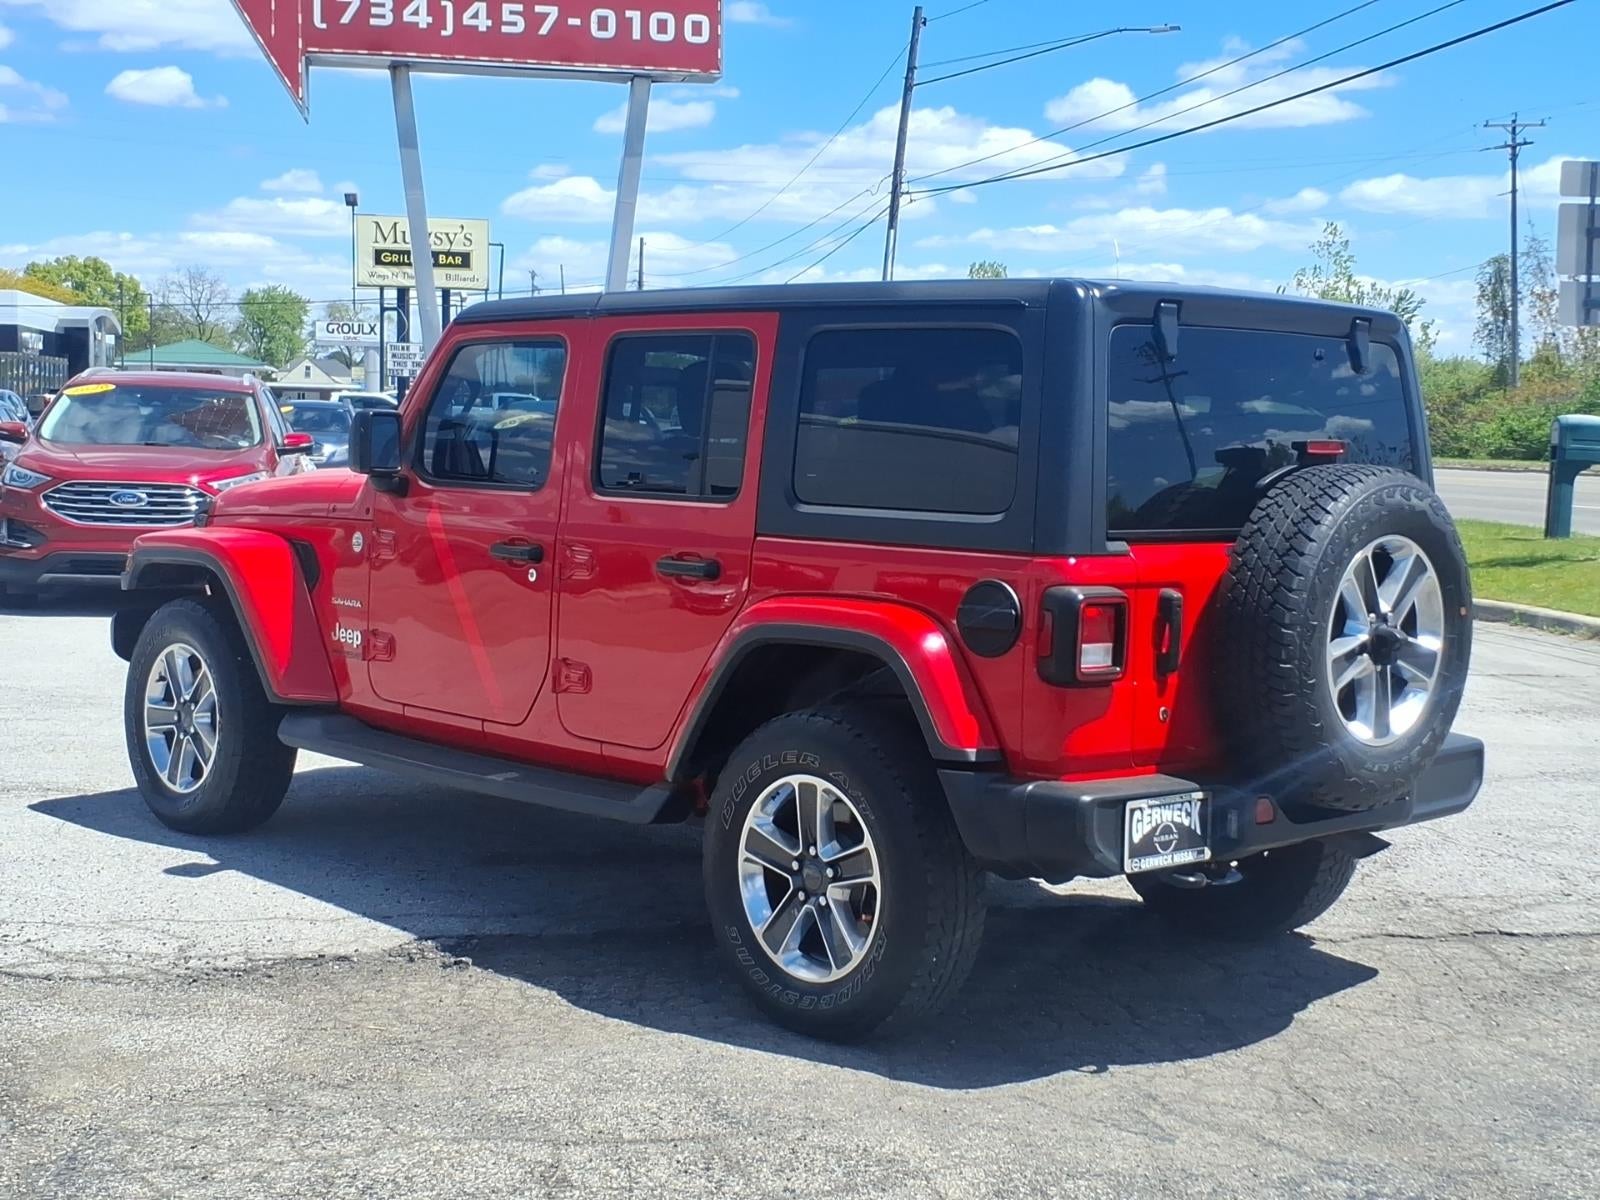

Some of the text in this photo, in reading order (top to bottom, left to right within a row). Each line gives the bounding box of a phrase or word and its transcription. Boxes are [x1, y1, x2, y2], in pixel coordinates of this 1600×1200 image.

[372, 220, 473, 253] Musy's
[380, 252, 411, 263] GRIL
[438, 254, 463, 265] BAR
[368, 271, 390, 281] Wings
[445, 273, 479, 283] Billiards
[326, 322, 377, 336] GROULX
[331, 597, 362, 608] SAHARA
[331, 622, 362, 648] Jeep
[721, 750, 820, 830] DUELER
[1131, 800, 1202, 844] GERWECK
[1153, 833, 1179, 842] NISSAN
[1140, 853, 1173, 869] GERWECK
